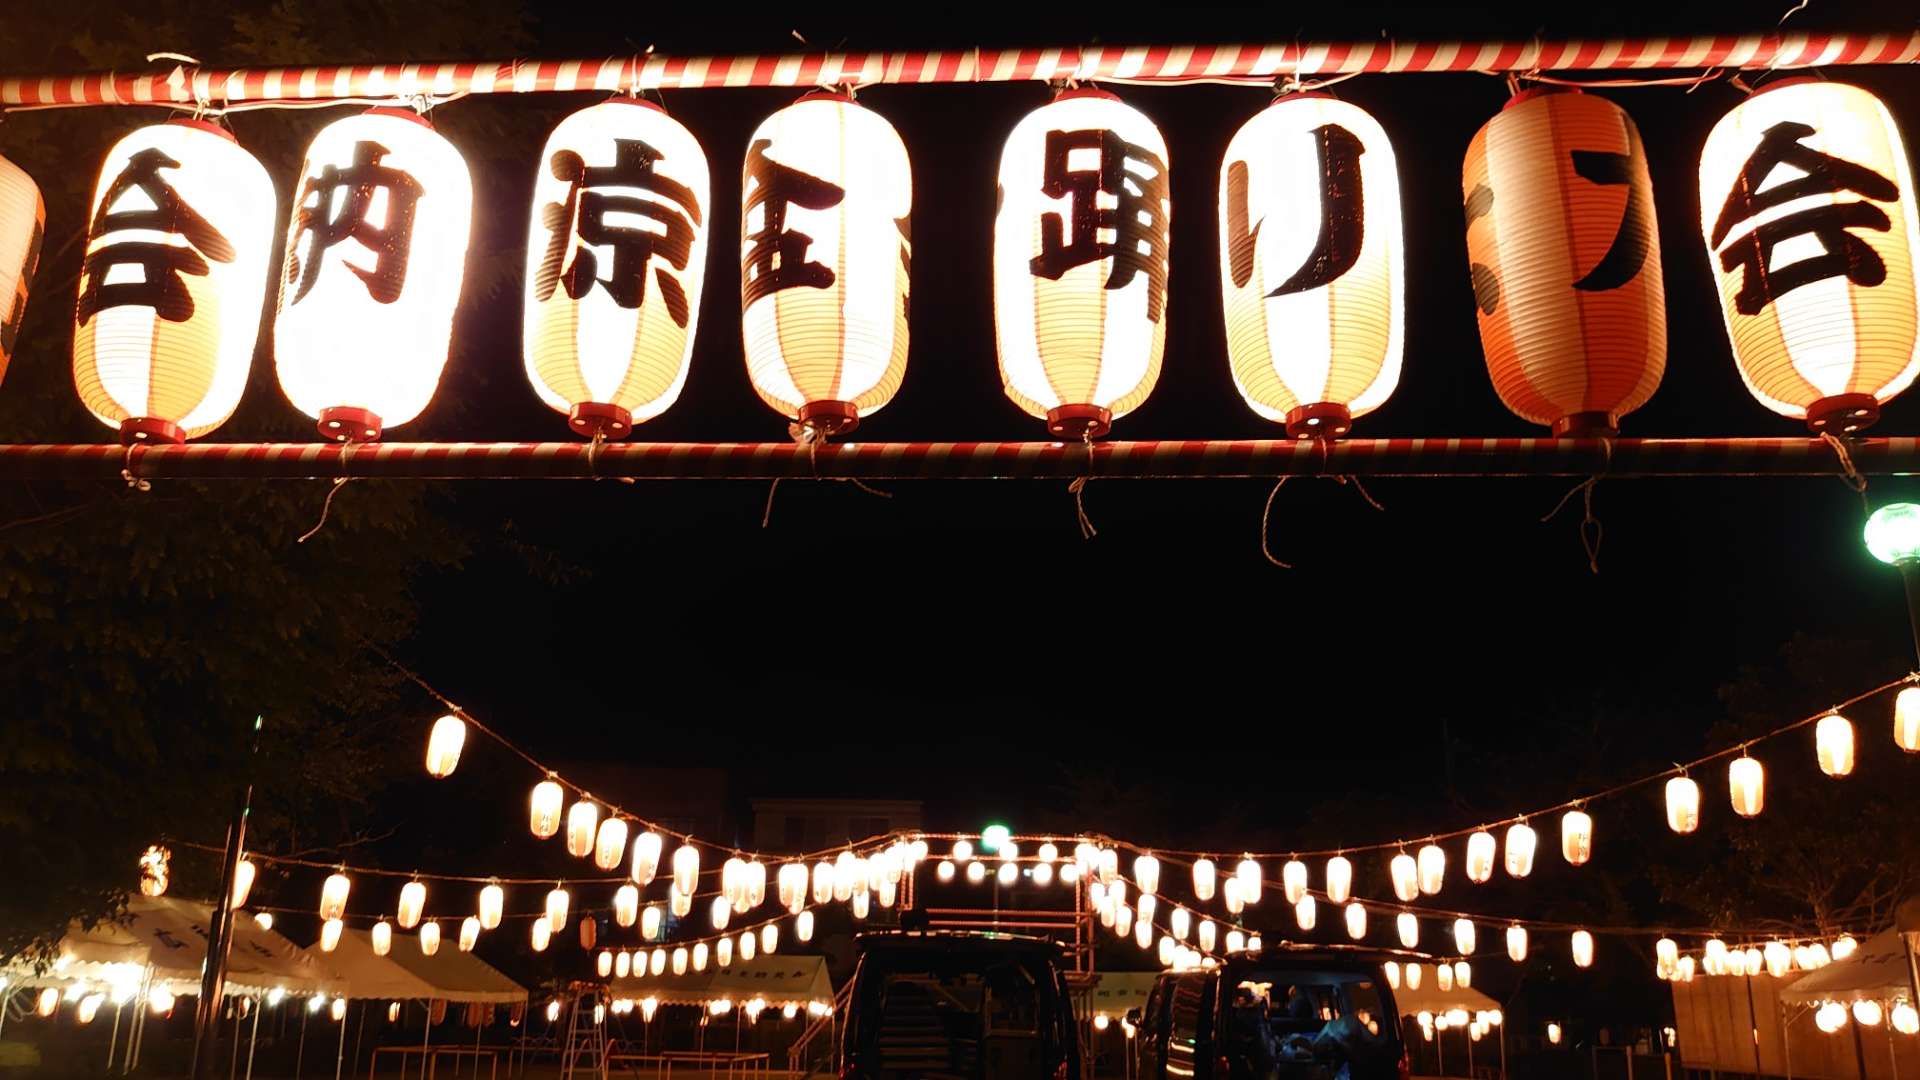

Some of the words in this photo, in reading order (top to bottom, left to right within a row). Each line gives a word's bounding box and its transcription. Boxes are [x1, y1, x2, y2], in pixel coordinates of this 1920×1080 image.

[78, 147, 236, 328] 会
[534, 138, 702, 328] 涼
[1029, 128, 1168, 324] 踊
[1226, 123, 1365, 299] り
[1711, 120, 1900, 316] 会
